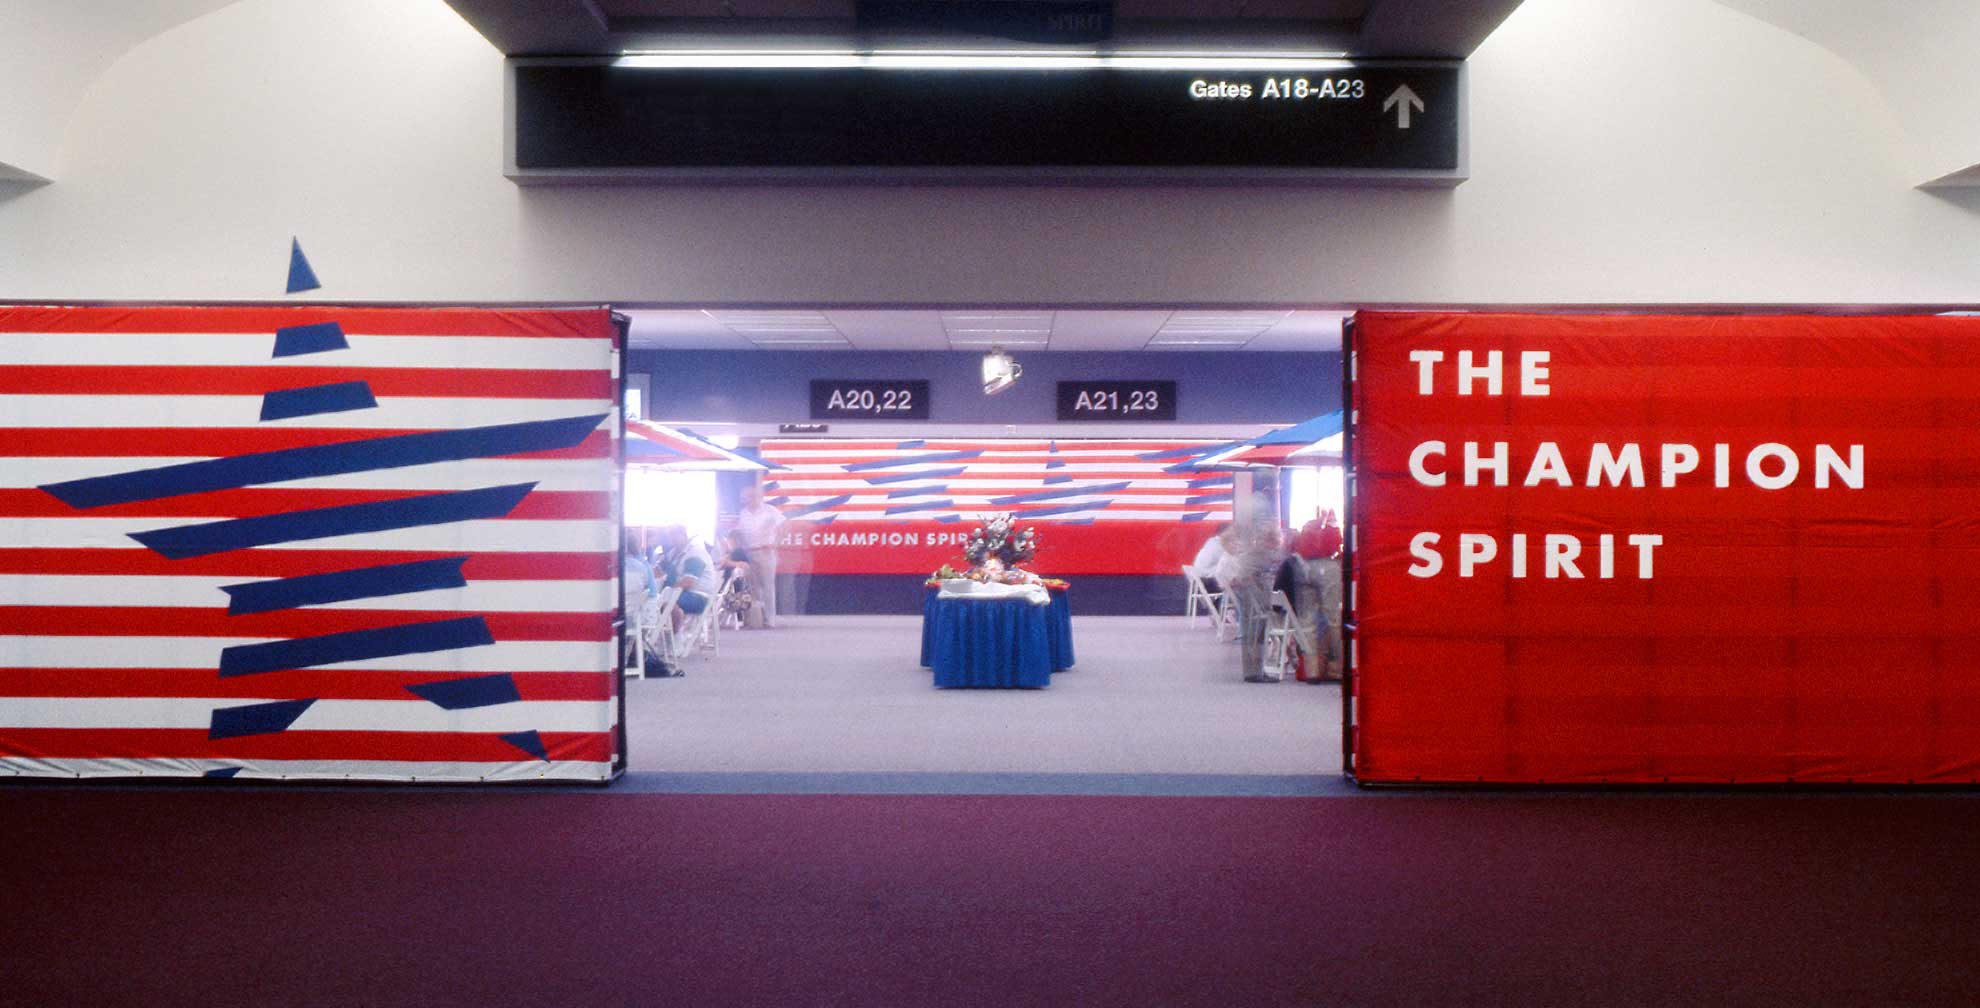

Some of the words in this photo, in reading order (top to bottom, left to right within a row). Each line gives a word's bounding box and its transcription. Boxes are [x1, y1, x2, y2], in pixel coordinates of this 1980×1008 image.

[1190, 79, 1253, 99] Gates
[1261, 78, 1366, 99] A18-A23
[1409, 350, 1551, 397] THE
[827, 389, 913, 414] A20,22
[1074, 391, 1159, 414] A21,23
[1408, 441, 1865, 490] CHAMPION
[810, 532, 919, 545] CHAMPION
[926, 533, 968, 545] SPIR
[1407, 531, 1664, 579] SPIRIT
